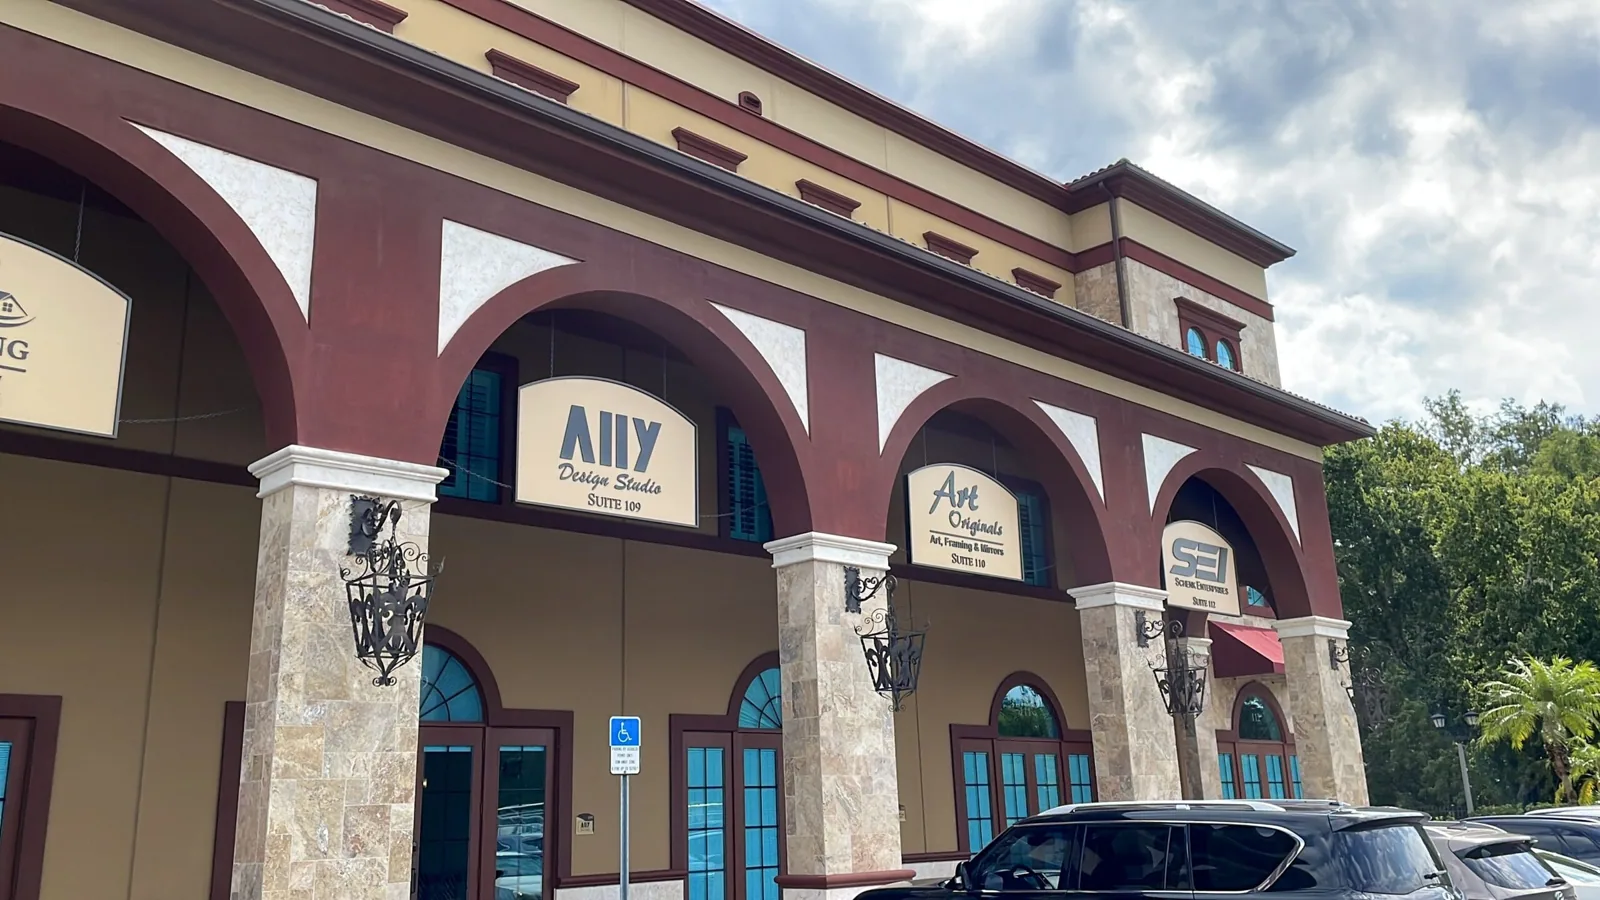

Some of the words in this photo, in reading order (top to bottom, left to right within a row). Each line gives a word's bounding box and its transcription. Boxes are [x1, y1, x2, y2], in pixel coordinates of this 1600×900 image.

[558, 462, 609, 490] Design
[613, 473, 661, 494] Studio
[588, 493, 622, 510] SUITE
[624, 500, 641, 512] 109
[928, 470, 979, 514] Art
[948, 510, 1003, 536] Originals
[930, 535, 943, 547] Art,
[944, 537, 973, 552] Framing
[974, 543, 980, 552] &
[981, 543, 1004, 556] Mirrors
[951, 553, 974, 567] SUITE
[975, 558, 986, 568] 110
[1169, 537, 1228, 584] SEI
[1192, 597, 1208, 607] SUITE
[1208, 600, 1216, 608] 112
